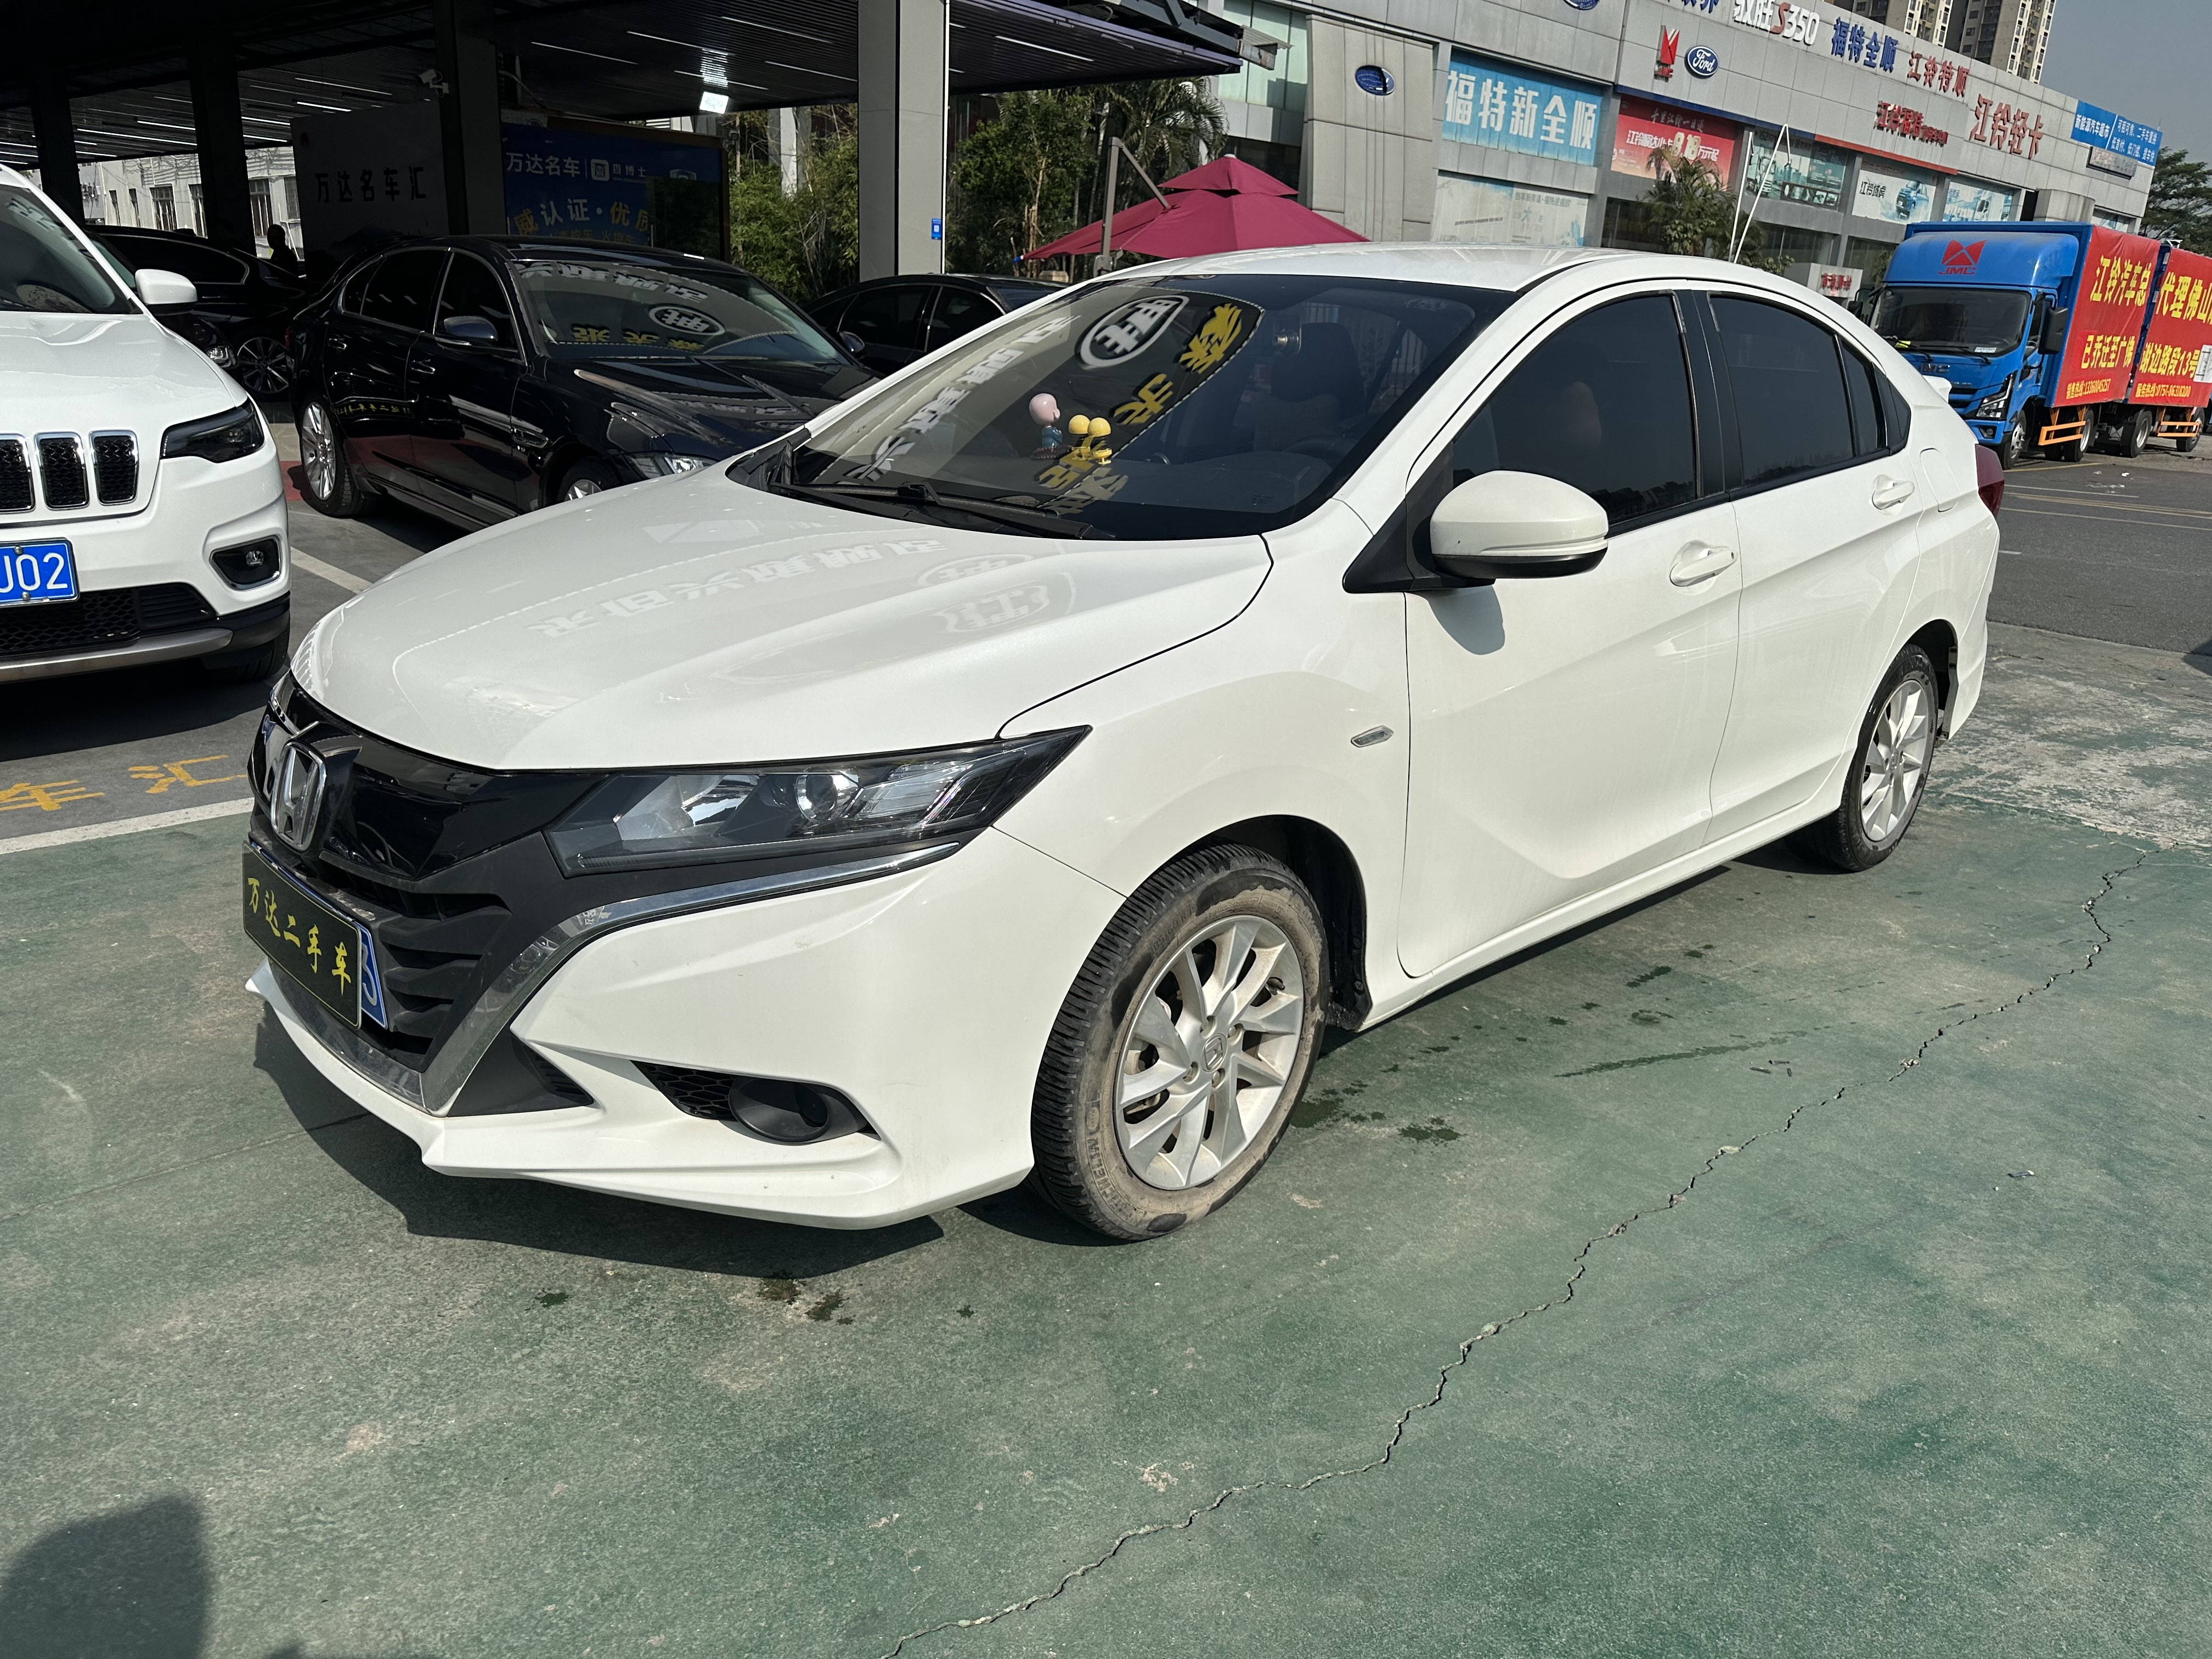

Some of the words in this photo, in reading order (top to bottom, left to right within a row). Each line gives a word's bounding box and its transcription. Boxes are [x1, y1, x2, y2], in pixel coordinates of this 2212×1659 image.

[1692, 49, 1716, 72] Ford
[1831, 16, 1898, 73] 福特全顺
[1907, 50, 1970, 98] 江铃特顺
[1445, 70, 1597, 150] 福特新全顺
[1968, 93, 2044, 160] 江铃轻卡
[2075, 114, 2111, 138] 新能源汽车超市
[315, 166, 426, 203] 万达名车汇
[505, 151, 580, 177] 万达名车
[1938, 267, 1977, 275] JMC
[2090, 255, 2151, 306] 江铃汽车总
[2155, 272, 2212, 325] 代理佛山
[2081, 335, 2135, 369] 已乔迁至广佛
[2140, 342, 2200, 379] 谢边路段13号
[247, 878, 351, 996] 万达二手车
